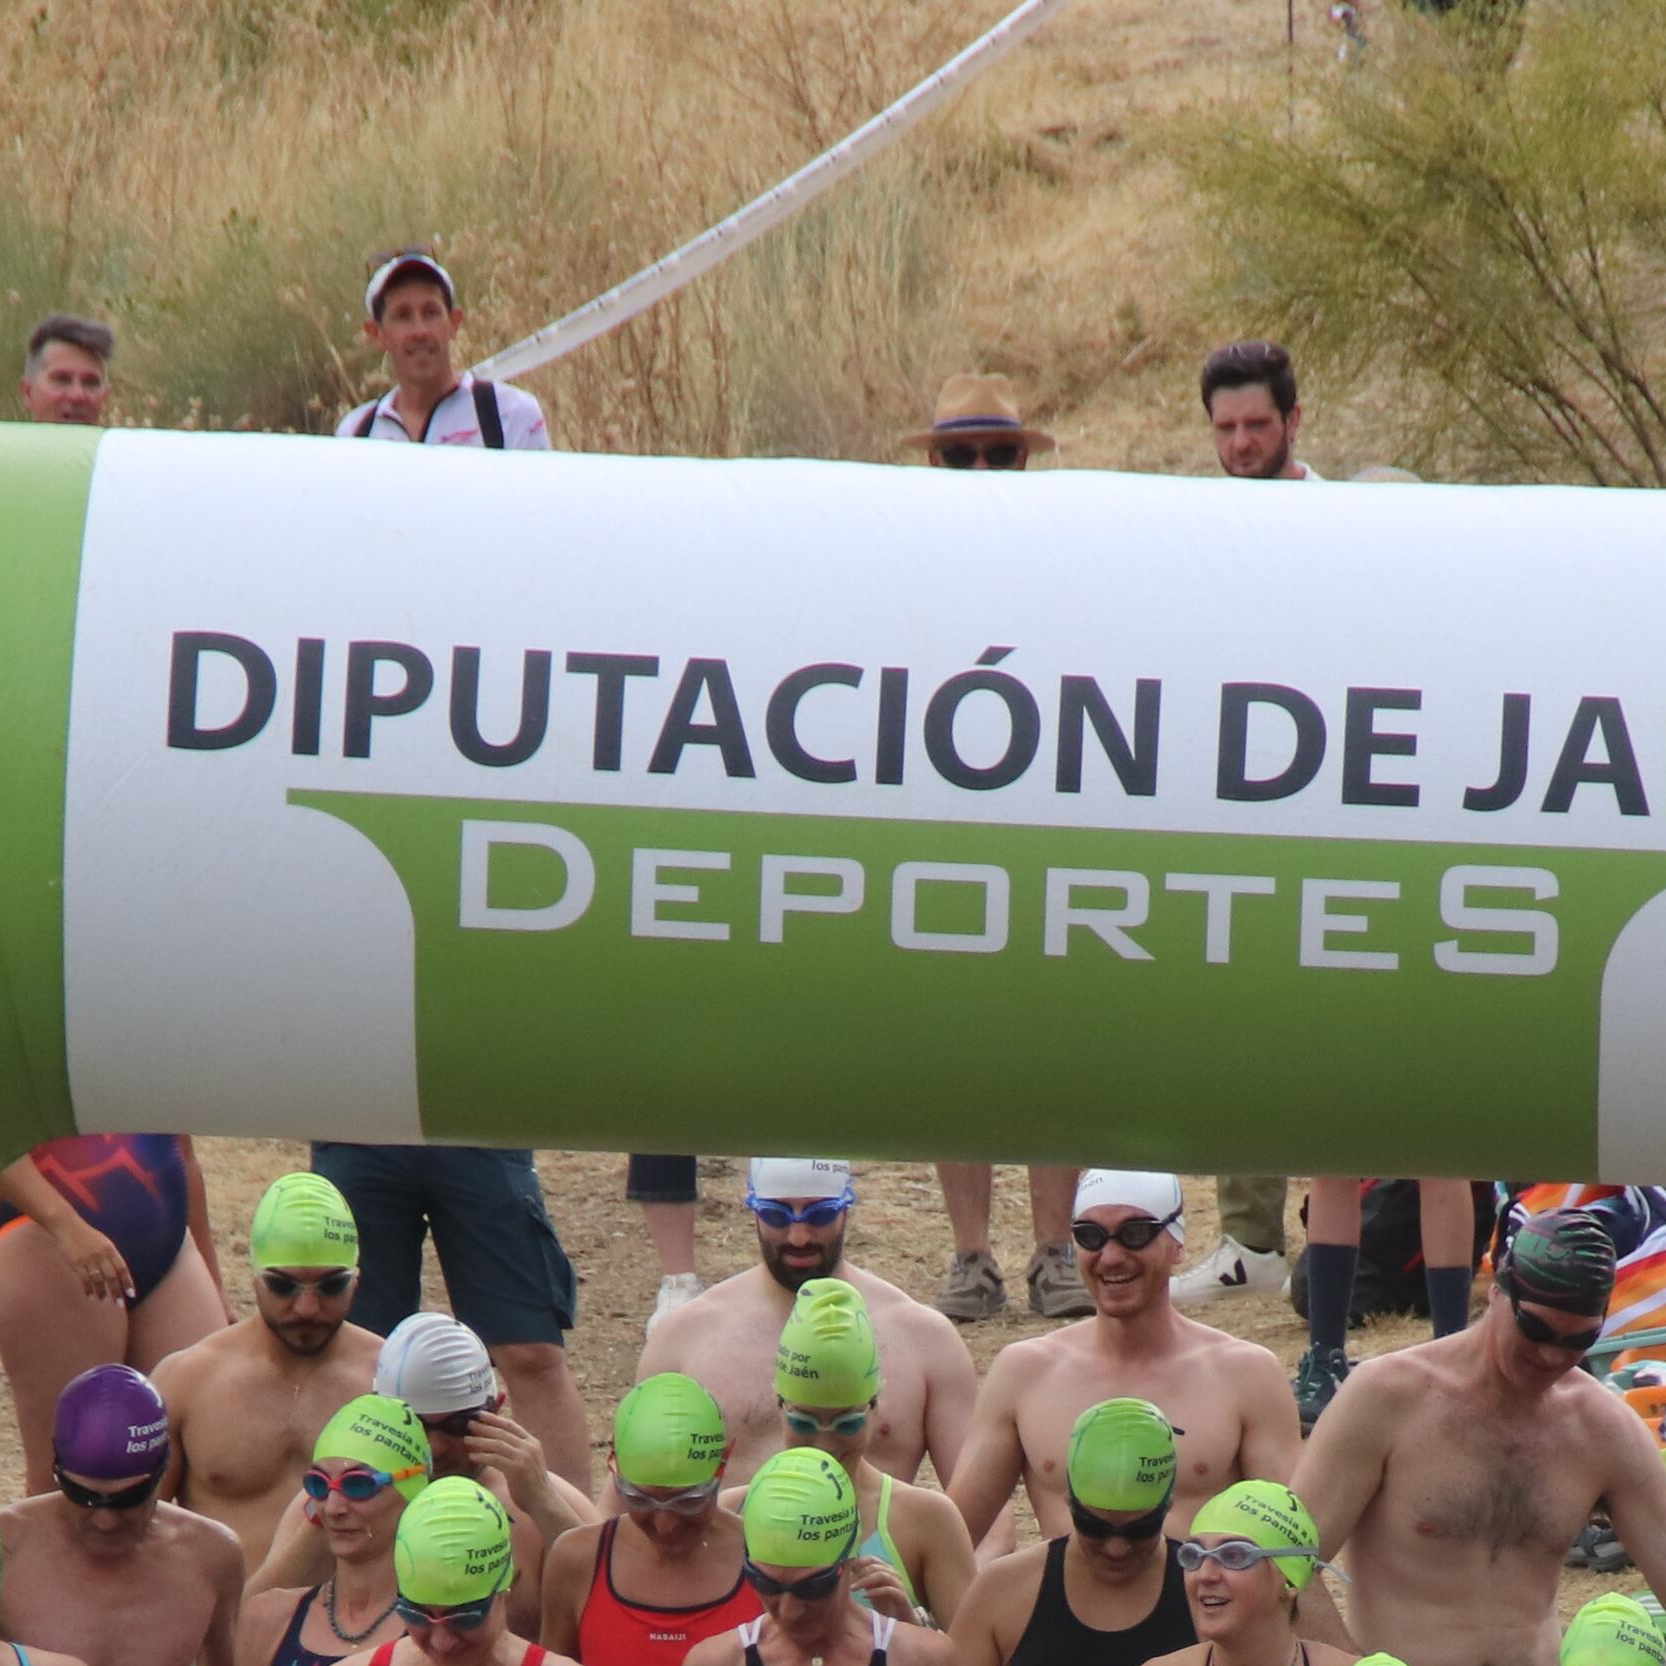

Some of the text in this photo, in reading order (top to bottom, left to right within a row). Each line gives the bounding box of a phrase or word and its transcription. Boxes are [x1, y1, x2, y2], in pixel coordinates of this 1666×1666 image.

[166, 630, 1162, 798] DIPUTACIÓN
[1216, 681, 1422, 809] DE
[458, 819, 1561, 977] DEPORTES
[126, 1440, 147, 1454] los
[349, 1422, 420, 1466] los pantan
[687, 1447, 707, 1460] los
[1136, 1470, 1156, 1482] los
[1235, 1501, 1304, 1548] los pantan
[797, 1528, 821, 1541] los
[464, 1563, 485, 1576] los
[1616, 1630, 1635, 1645] los
